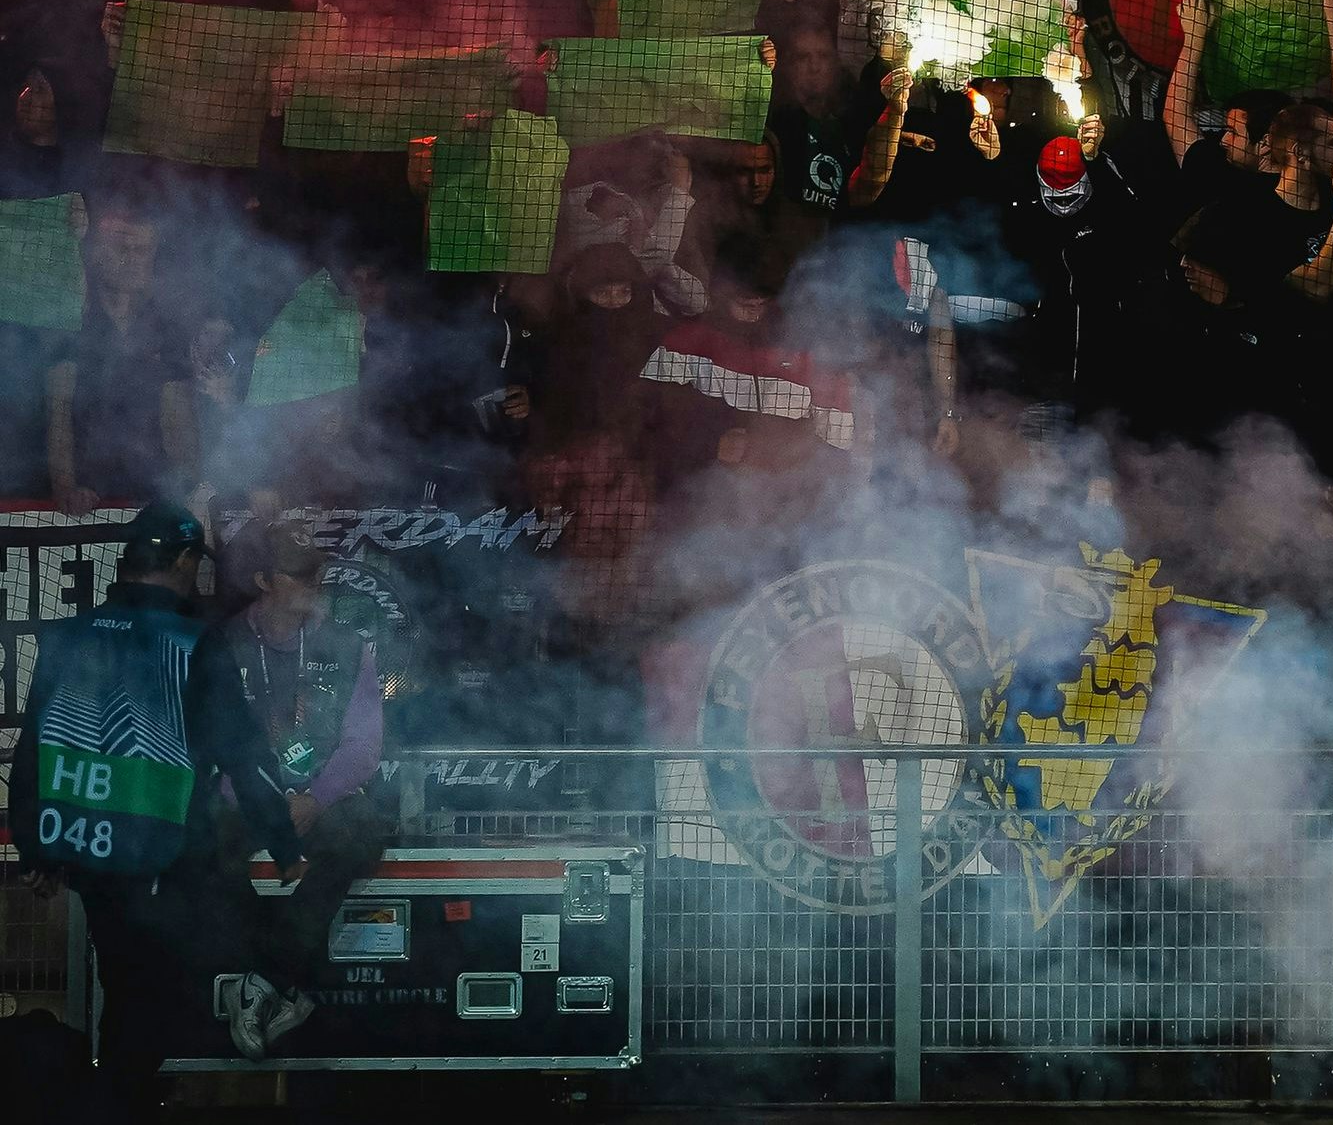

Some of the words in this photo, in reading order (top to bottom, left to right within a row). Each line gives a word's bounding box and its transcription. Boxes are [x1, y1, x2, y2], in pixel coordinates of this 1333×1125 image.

[53, 755, 113, 801] HB
[39, 808, 113, 858] 048
[533, 948, 547, 961] 21
